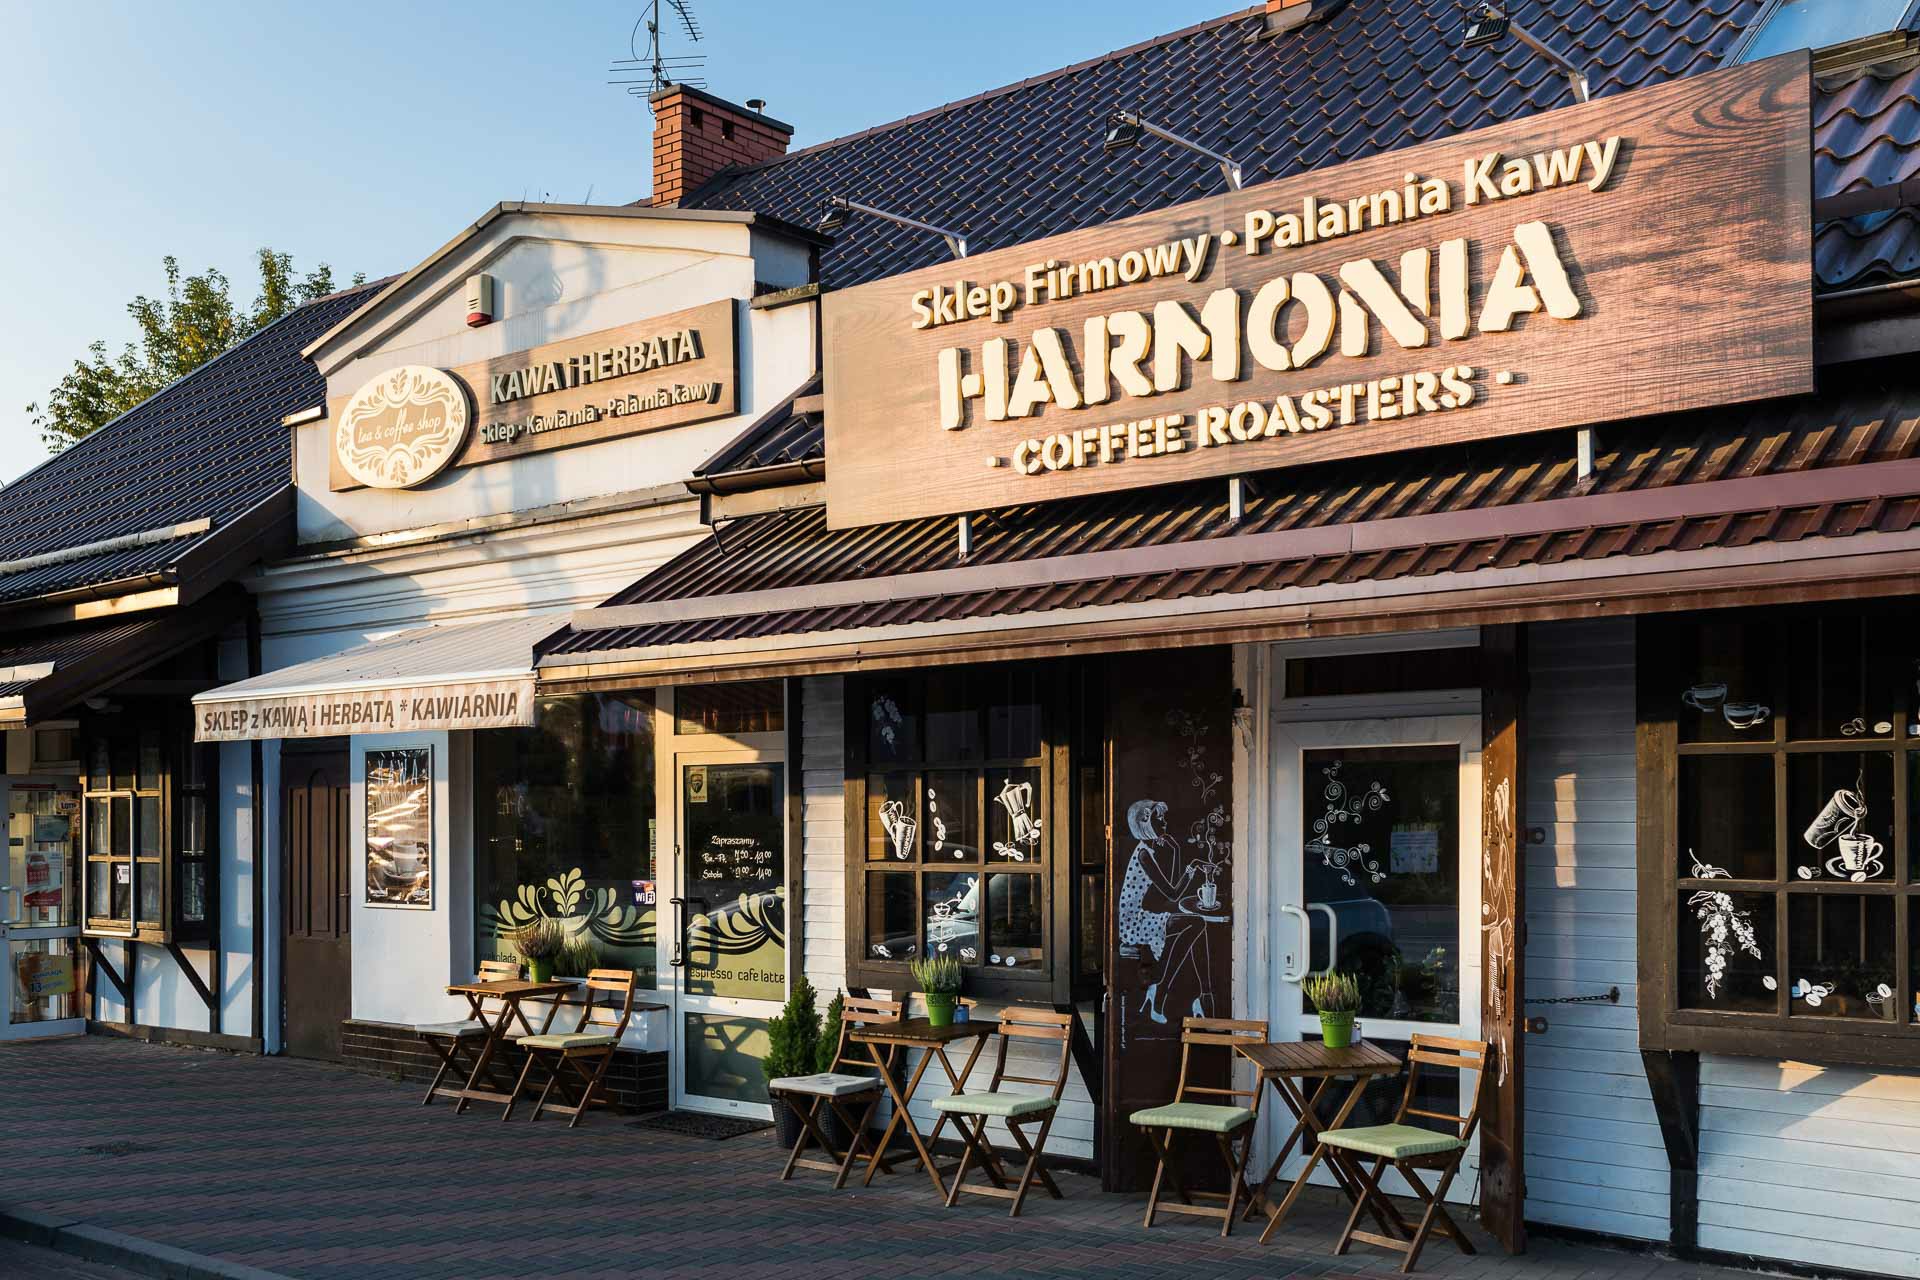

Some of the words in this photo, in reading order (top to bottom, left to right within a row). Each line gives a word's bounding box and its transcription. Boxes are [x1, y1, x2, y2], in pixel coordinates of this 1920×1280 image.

[911, 279, 1018, 329] Sklep
[1024, 233, 1212, 304] Firmowy
[1245, 171, 1451, 256] Palarnia
[1464, 135, 1622, 206] Kawy
[938, 220, 1583, 431] HARMONIA
[491, 361, 565, 404] KAWA
[578, 329, 704, 384] HERBATA
[358, 427, 373, 444] tea
[384, 407, 415, 443] coffee
[417, 407, 441, 433] shop
[480, 421, 519, 444] Sklep
[526, 404, 601, 435] Kawiarnia
[607, 388, 671, 418] Palarnia
[671, 382, 721, 405] kawy
[1012, 413, 1186, 475] COFFEE
[1197, 365, 1476, 448] ROASTERS
[204, 709, 249, 732] SKLEP
[250, 714, 259, 729] z
[262, 705, 308, 733] KAWĄ
[311, 704, 317, 727] i
[320, 699, 395, 729] HERBATĄ
[411, 692, 518, 721] KAWIARNIA
[711, 835, 755, 847] Zapraszamy
[690, 968, 733, 982] espresso
[737, 968, 759, 982] cafe
[760, 969, 785, 984] latte
